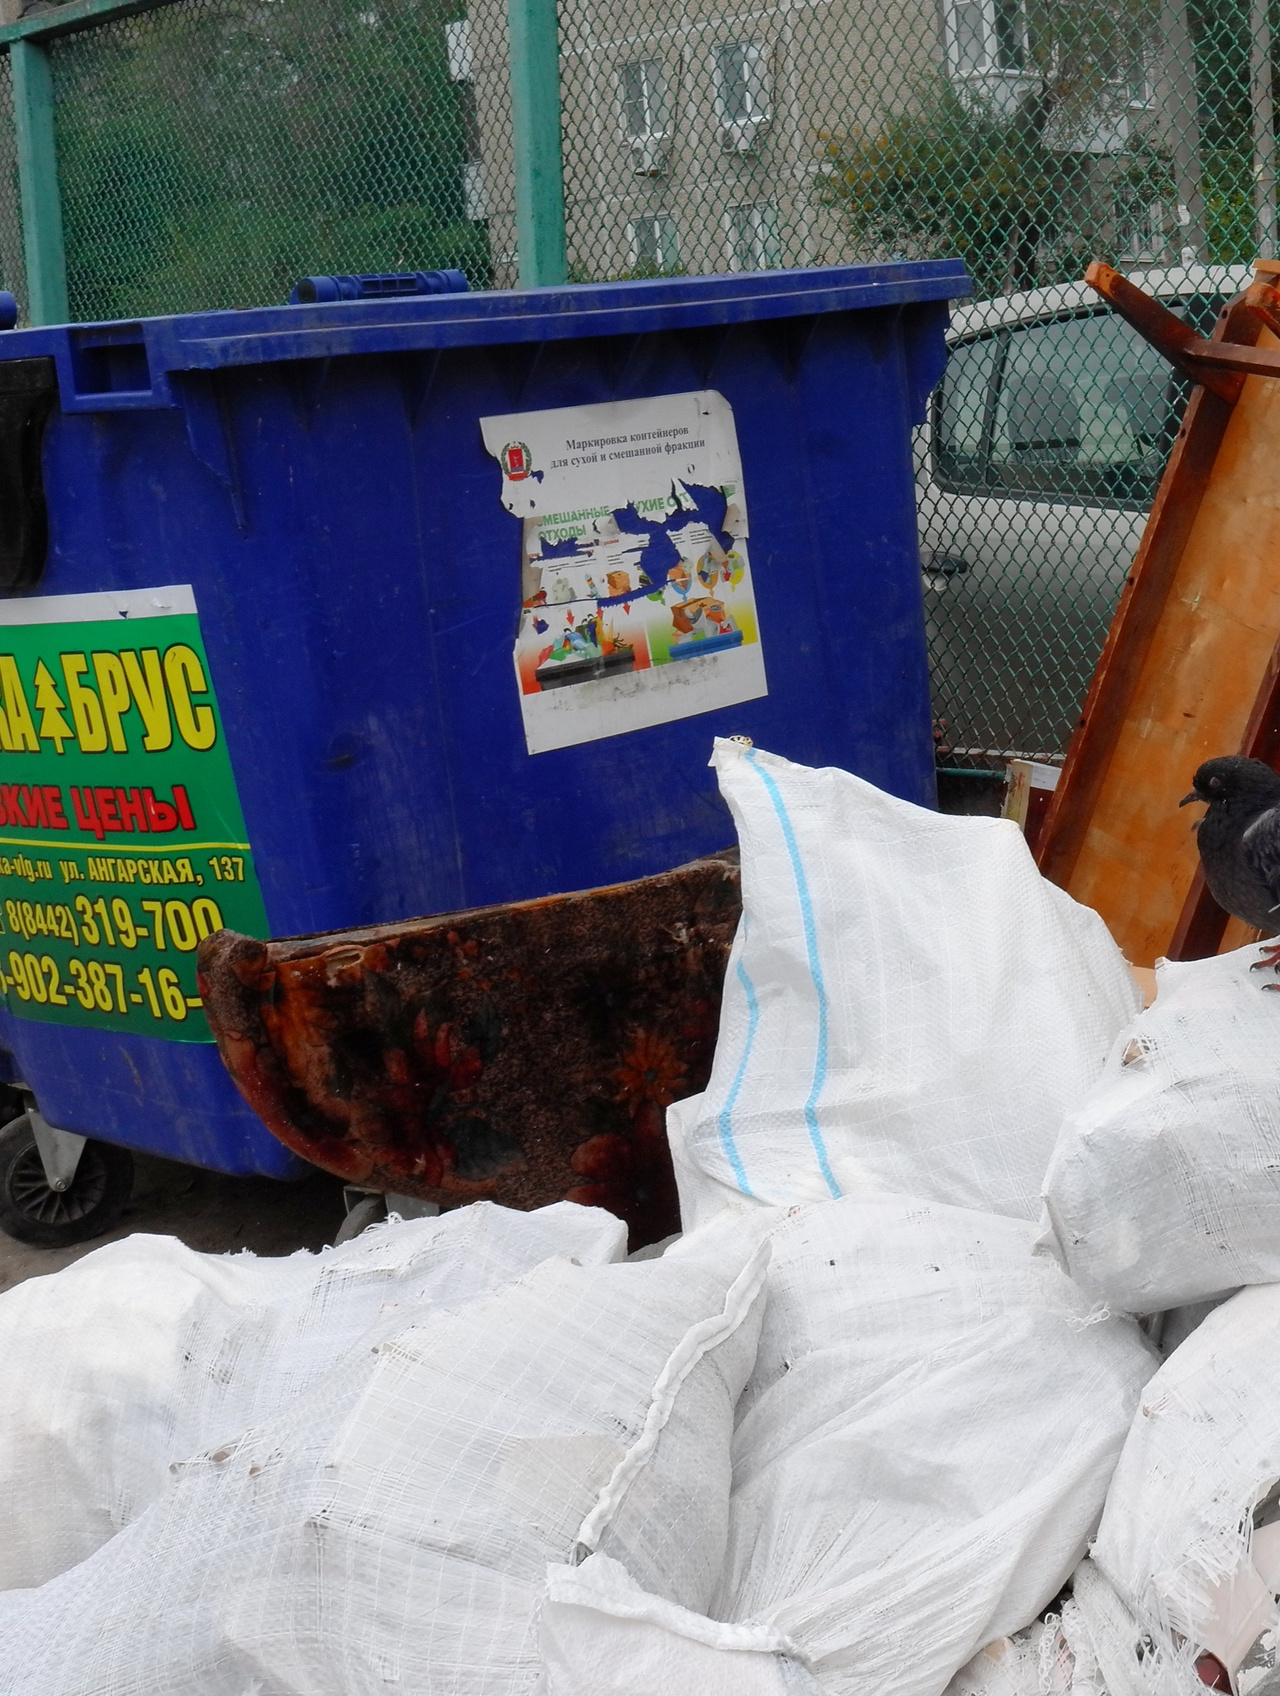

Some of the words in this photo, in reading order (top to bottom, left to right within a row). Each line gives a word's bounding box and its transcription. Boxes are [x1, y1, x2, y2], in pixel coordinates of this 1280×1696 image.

[566, 435, 628, 451] Маркировка
[630, 426, 689, 443] контейнеров
[551, 457, 569, 469] для
[571, 452, 598, 468] сухой
[600, 453, 607, 462] и
[608, 443, 662, 461] смешанной
[664, 439, 706, 455] фракции
[537, 505, 611, 527] МЕШАННЫЕ
[59, 643, 217, 754] БРУС
[69, 784, 197, 840] ЦЕНЫ
[58, 859, 85, 884] ул.
[87, 855, 204, 886] АНГАРСКАЯ,
[208, 856, 245, 882] 137
